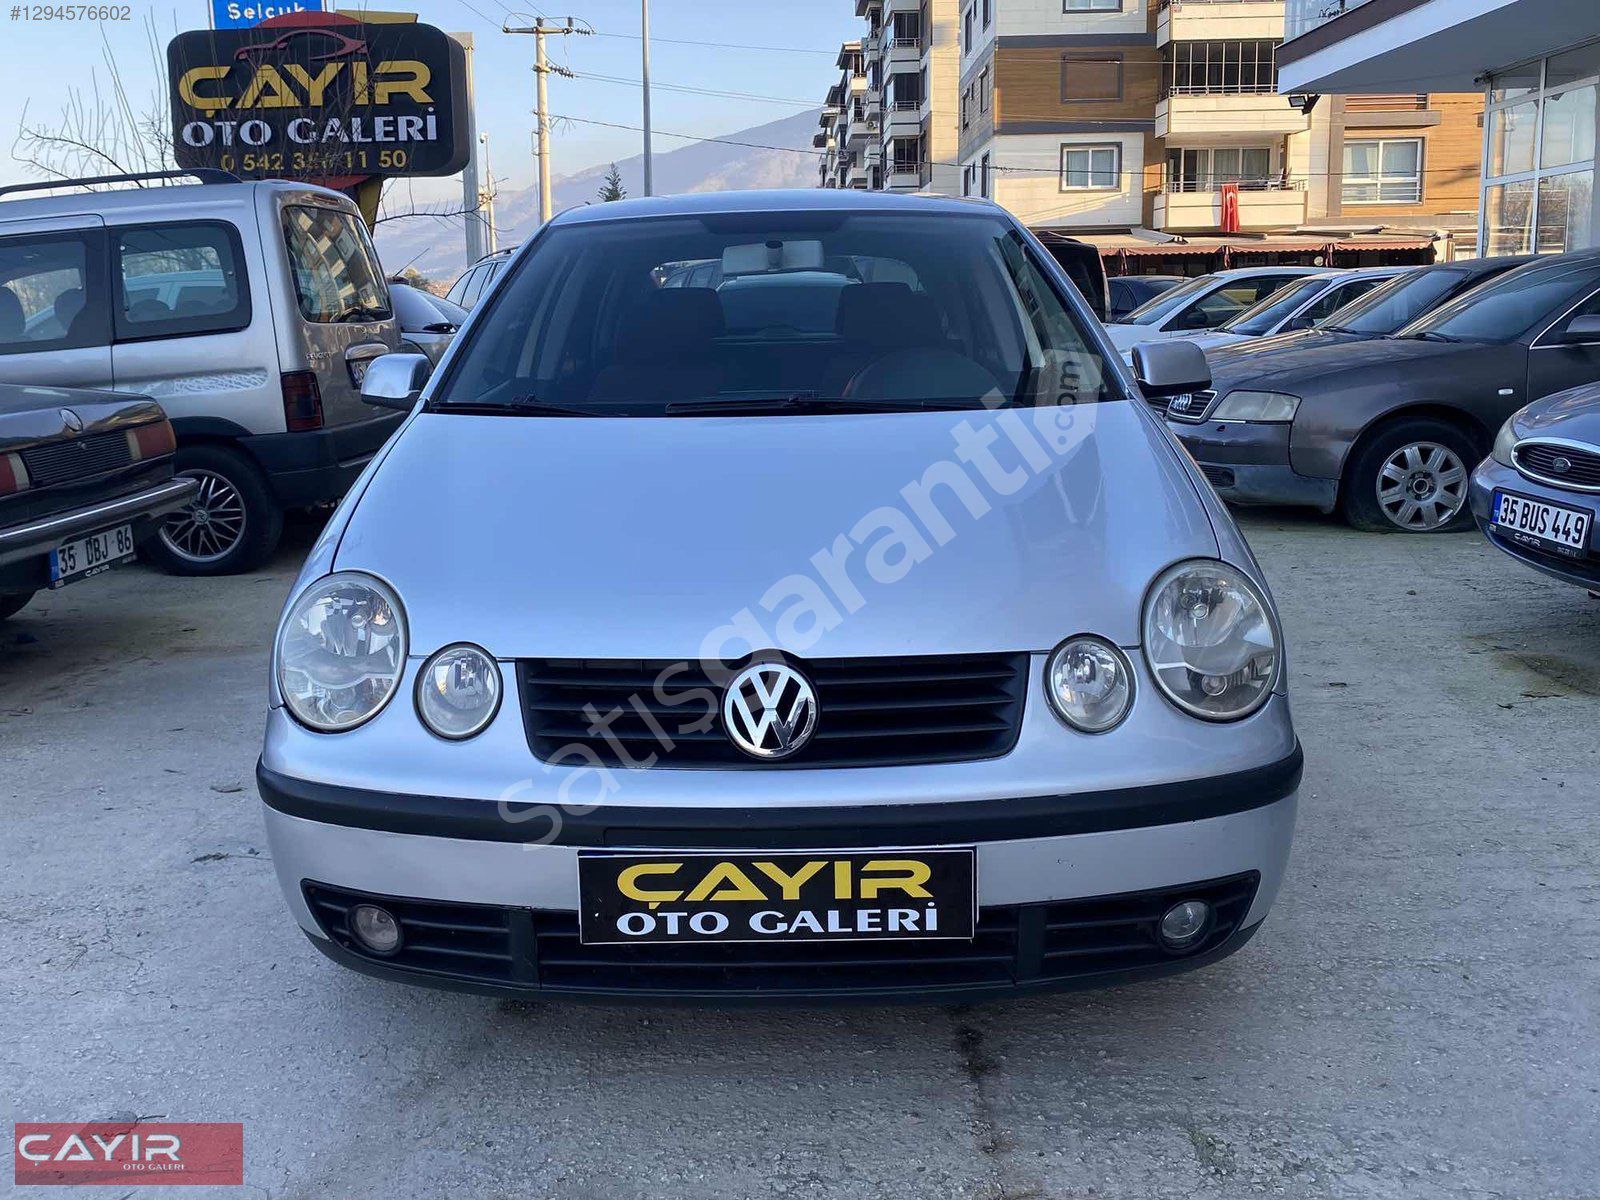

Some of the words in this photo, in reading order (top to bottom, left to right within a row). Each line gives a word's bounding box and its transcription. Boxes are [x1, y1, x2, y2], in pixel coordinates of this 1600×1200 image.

[179, 60, 435, 118] ÇAYIR
[182, 119, 272, 147] OTO
[287, 107, 437, 144] GALERİ
[243, 153, 284, 171] 542
[378, 150, 407, 168] 50
[1500, 497, 1517, 527] 35
[1519, 502, 1550, 534] BUS
[1551, 511, 1584, 544] 449
[59, 546, 76, 574] 35
[85, 535, 108, 565] DBJ
[116, 527, 131, 553] 86
[617, 859, 934, 910] ÇAYIR
[616, 912, 729, 936] OTO
[749, 901, 938, 935] GALERİ
